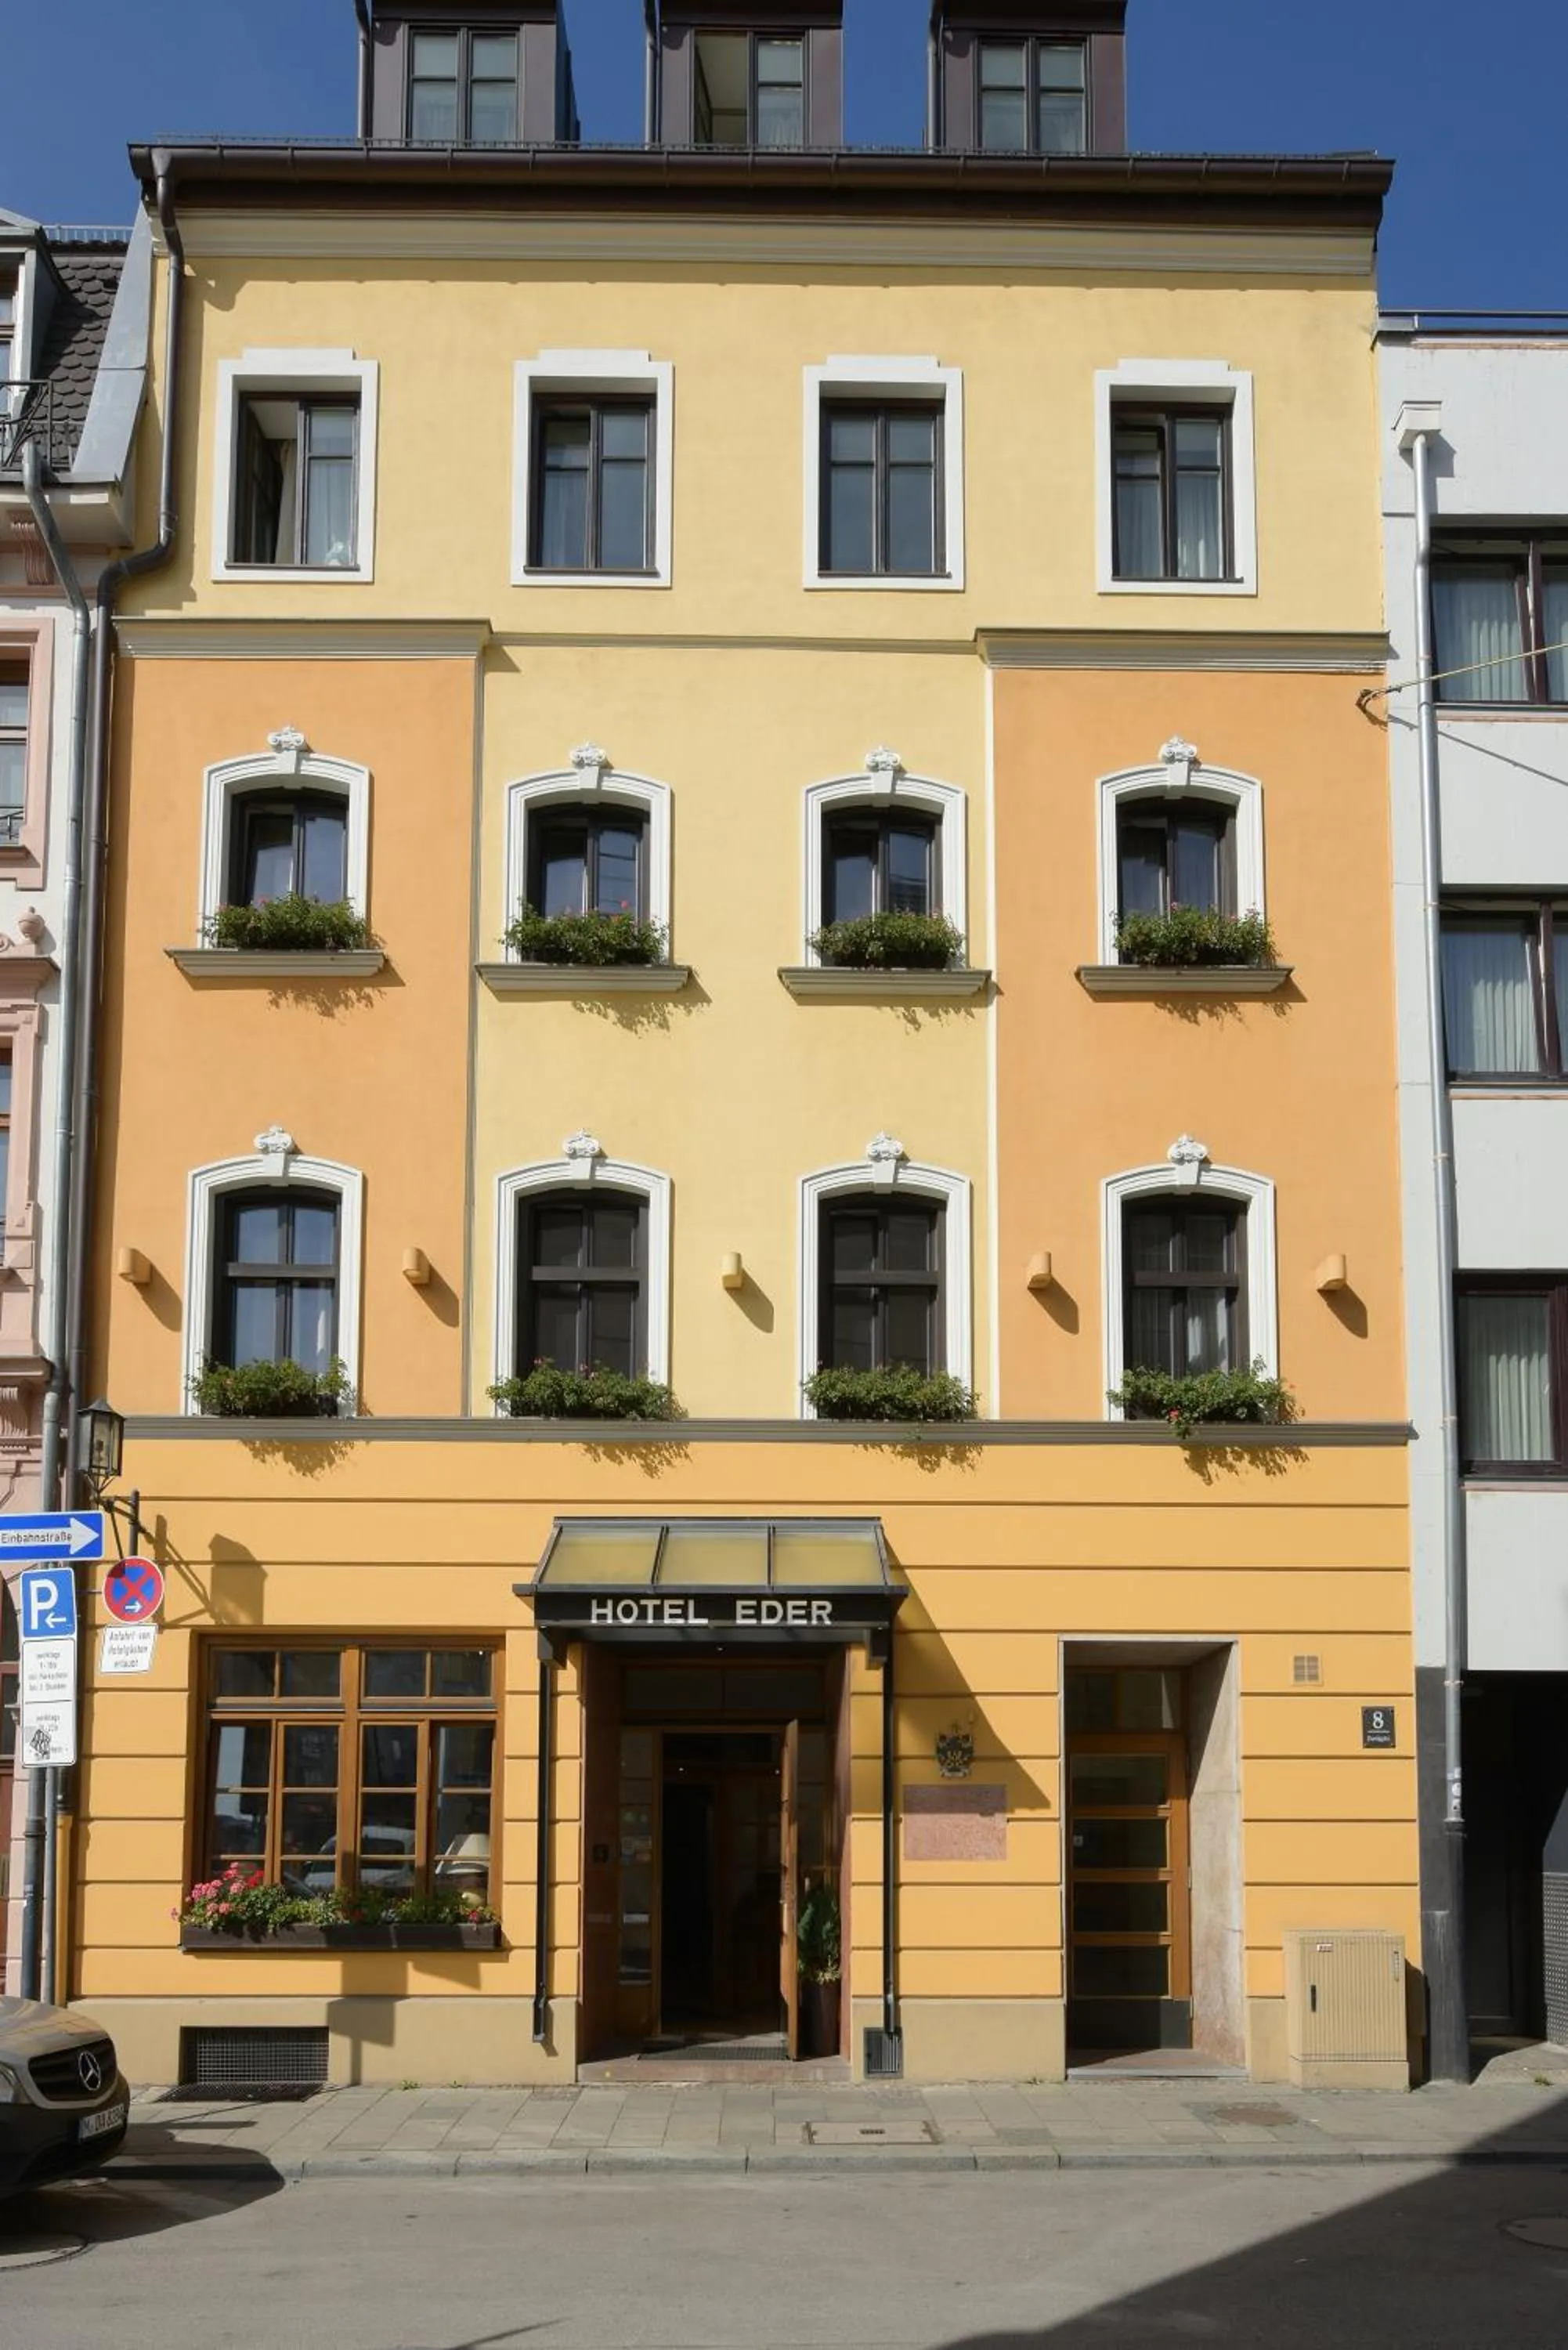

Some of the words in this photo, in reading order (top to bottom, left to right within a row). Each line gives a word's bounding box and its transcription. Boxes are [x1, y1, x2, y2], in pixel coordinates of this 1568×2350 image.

[1, 1531, 72, 1544] Einbahnstraße
[29, 1578, 59, 1630] P
[591, 1599, 709, 1625] HOTEL
[735, 1600, 833, 1625] EDER
[1372, 1710, 1384, 1730] 8
